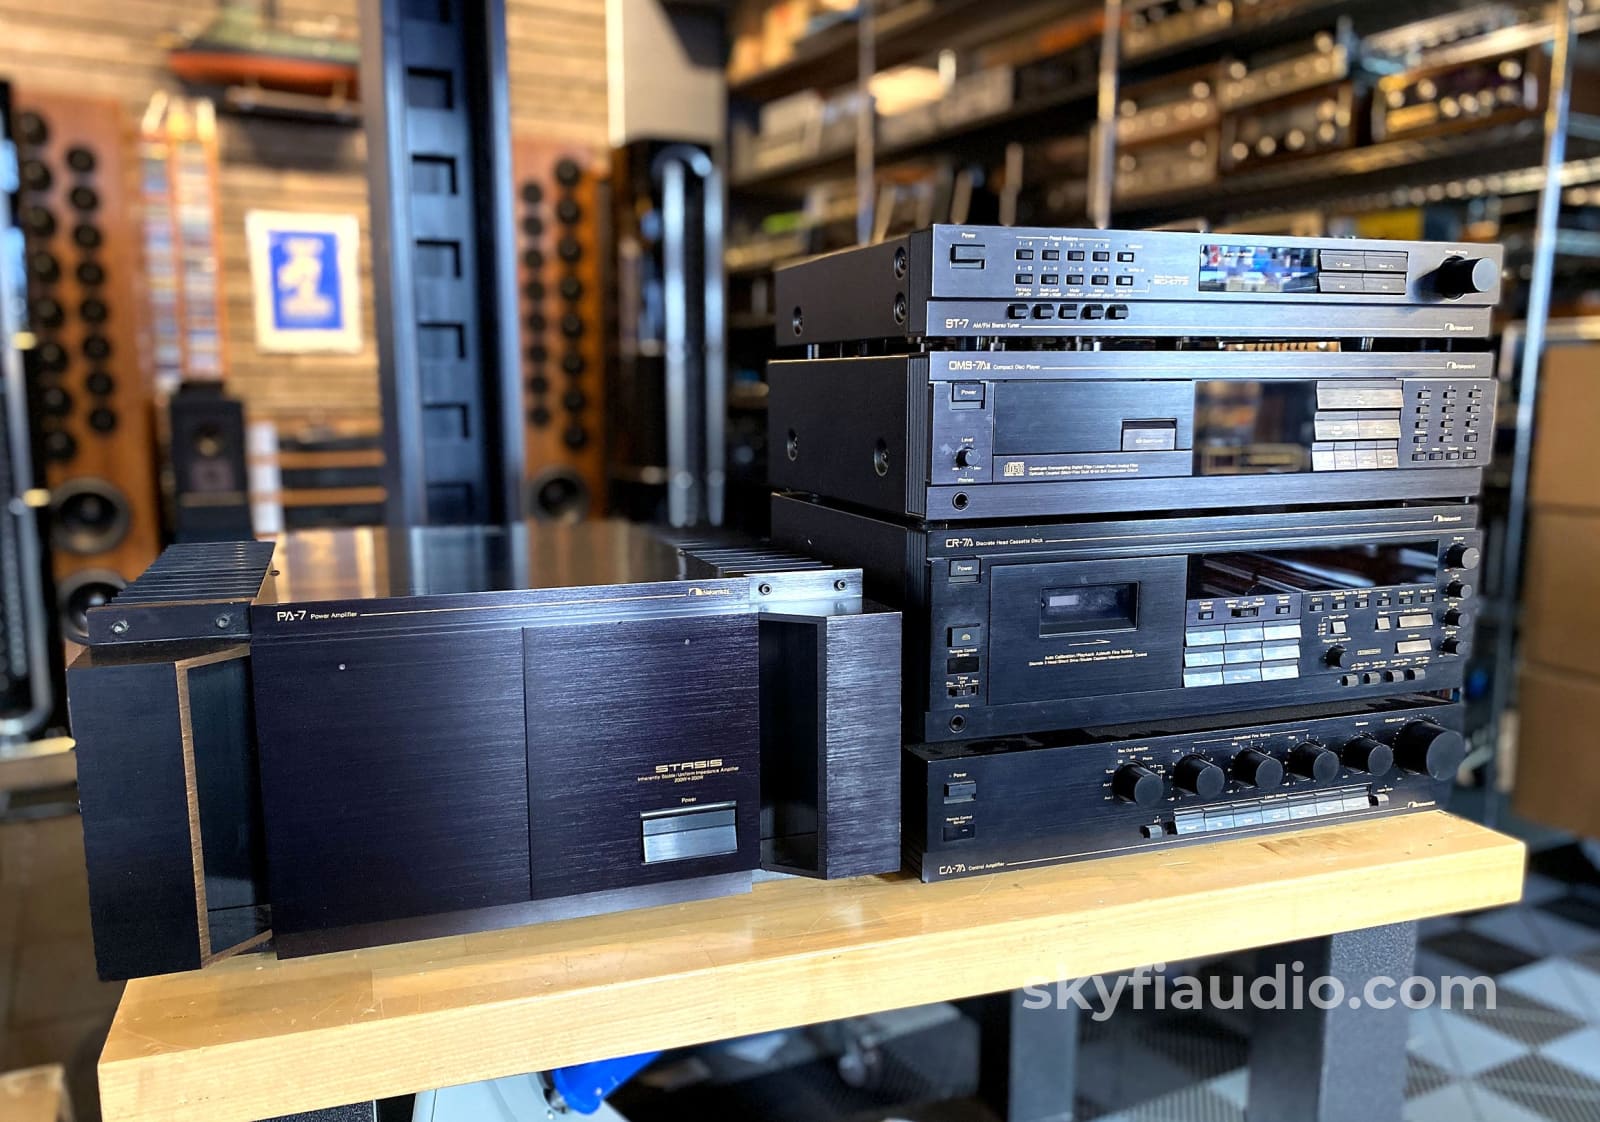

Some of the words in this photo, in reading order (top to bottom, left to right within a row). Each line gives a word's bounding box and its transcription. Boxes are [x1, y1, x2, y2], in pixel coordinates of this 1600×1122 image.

[945, 319, 970, 329] ST-7
[945, 538, 974, 548] CR-7A
[276, 610, 307, 622] PA-7
[655, 759, 723, 774] STASIS
[939, 863, 966, 875] CA-7A
